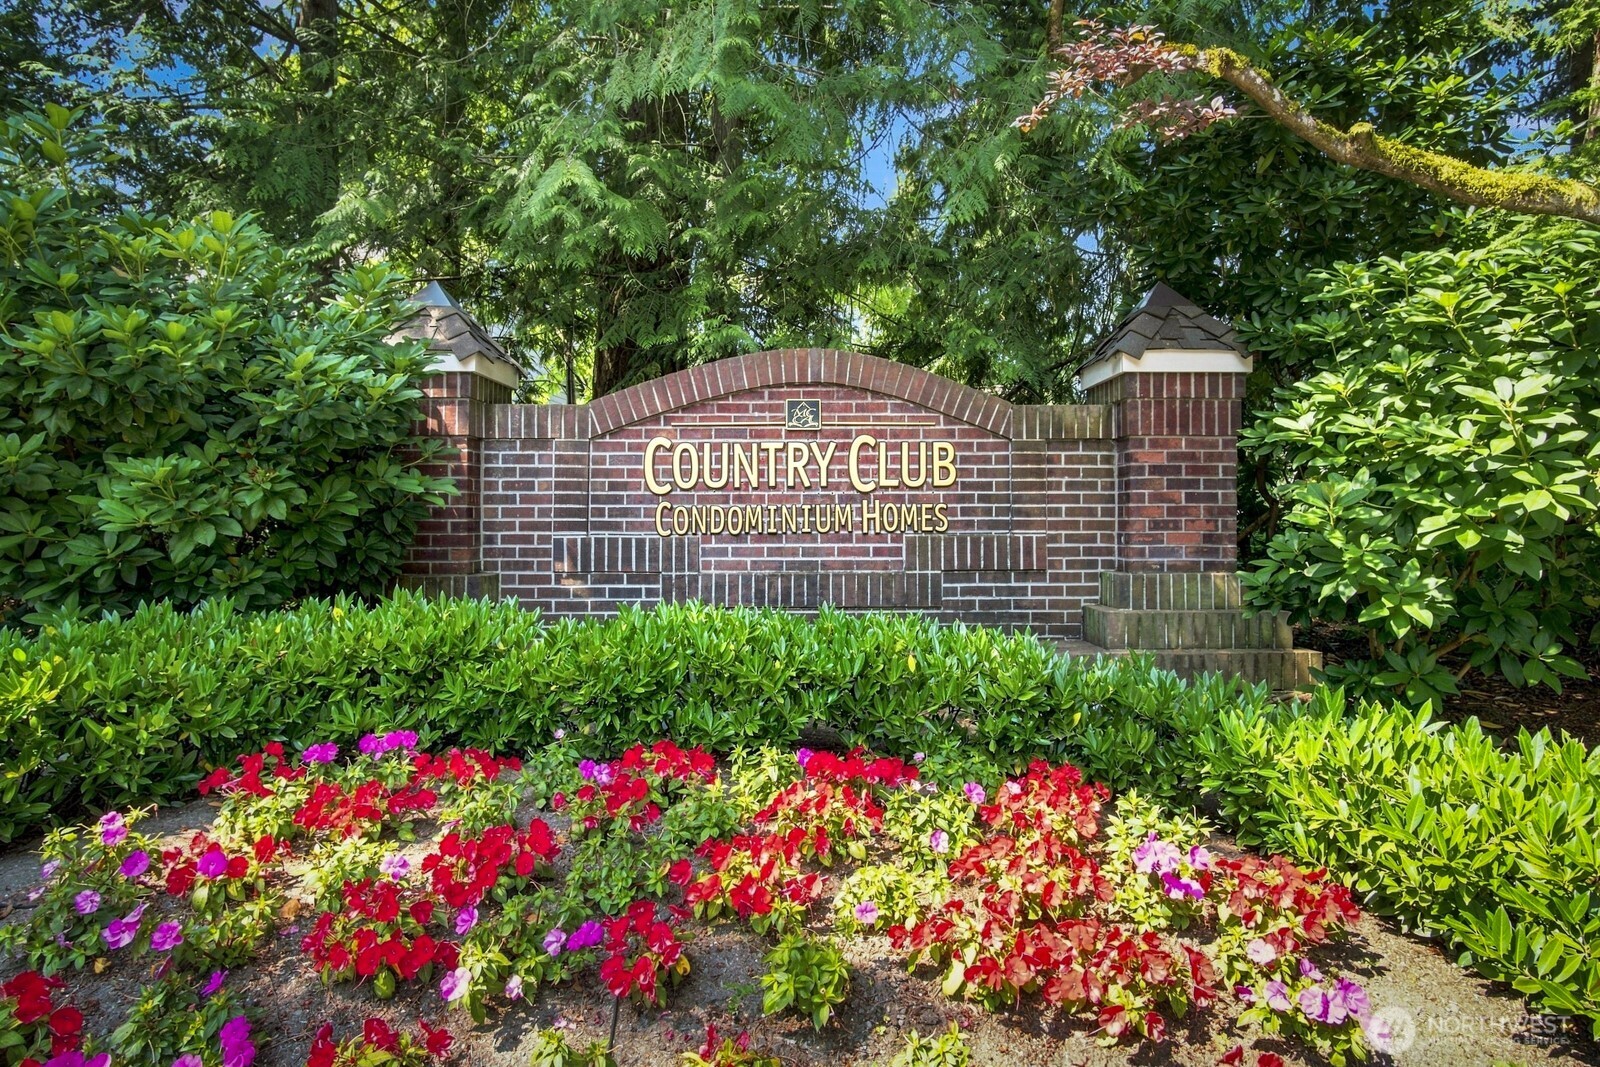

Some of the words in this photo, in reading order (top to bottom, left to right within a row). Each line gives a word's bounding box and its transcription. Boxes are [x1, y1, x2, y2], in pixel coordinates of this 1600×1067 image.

[644, 436, 837, 495] COUNTRY
[848, 434, 957, 493] CLUB
[655, 501, 853, 536] CONDOMINIUM
[862, 499, 949, 534] HOMES
